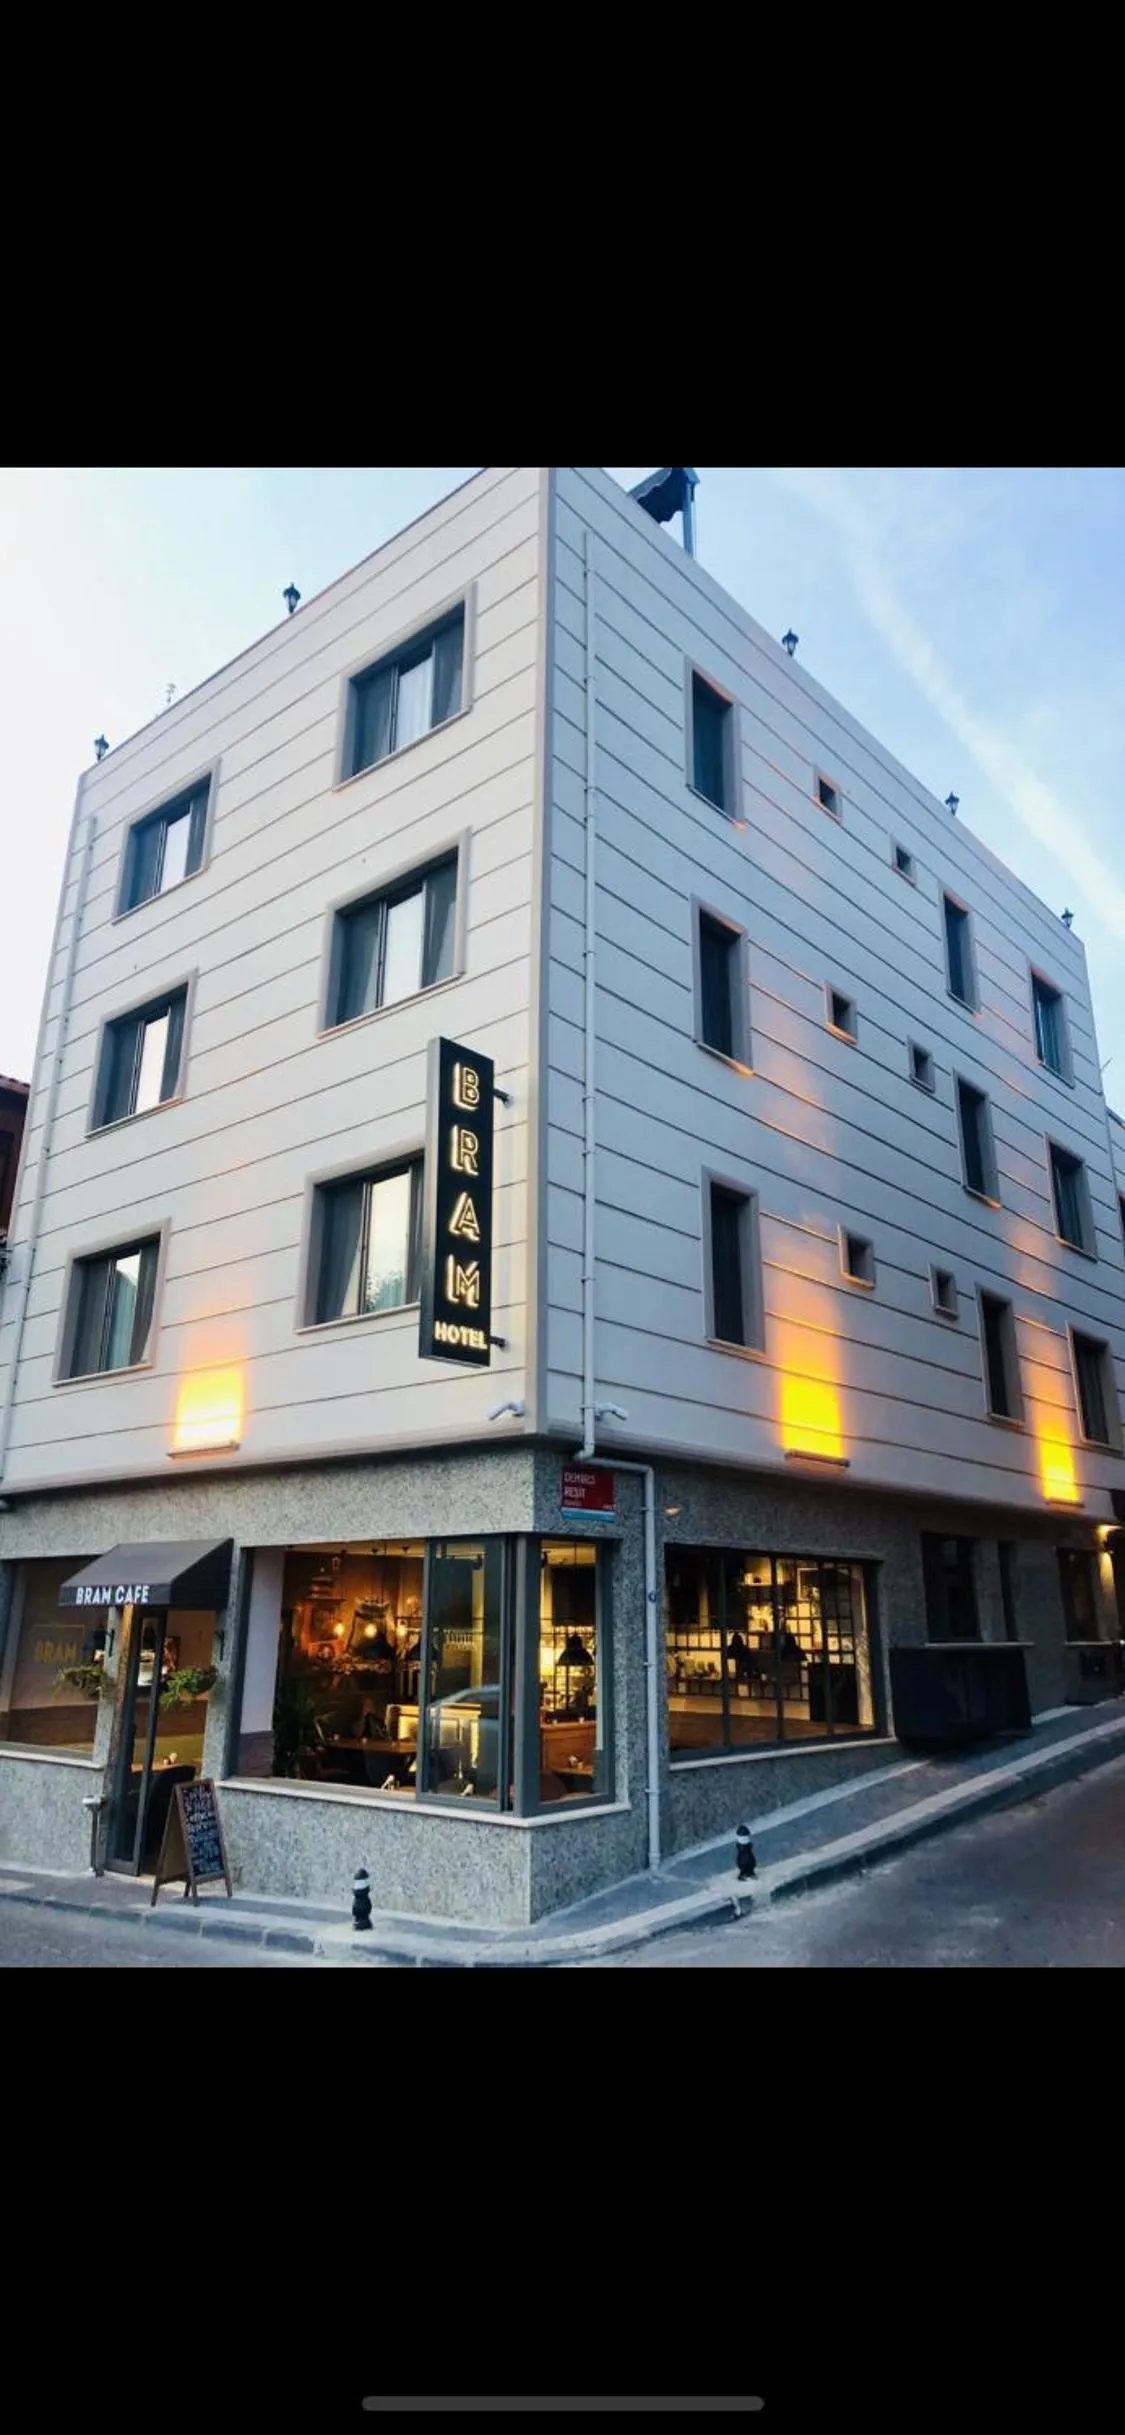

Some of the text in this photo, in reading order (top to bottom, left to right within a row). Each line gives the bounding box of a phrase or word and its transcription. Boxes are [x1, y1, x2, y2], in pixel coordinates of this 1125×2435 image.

[444, 1060, 482, 1311] BRAM
[434, 1319, 488, 1350] HOTEL
[75, 1585, 150, 1605] BRAM CAFE
[34, 1640, 78, 1663] BRAM
